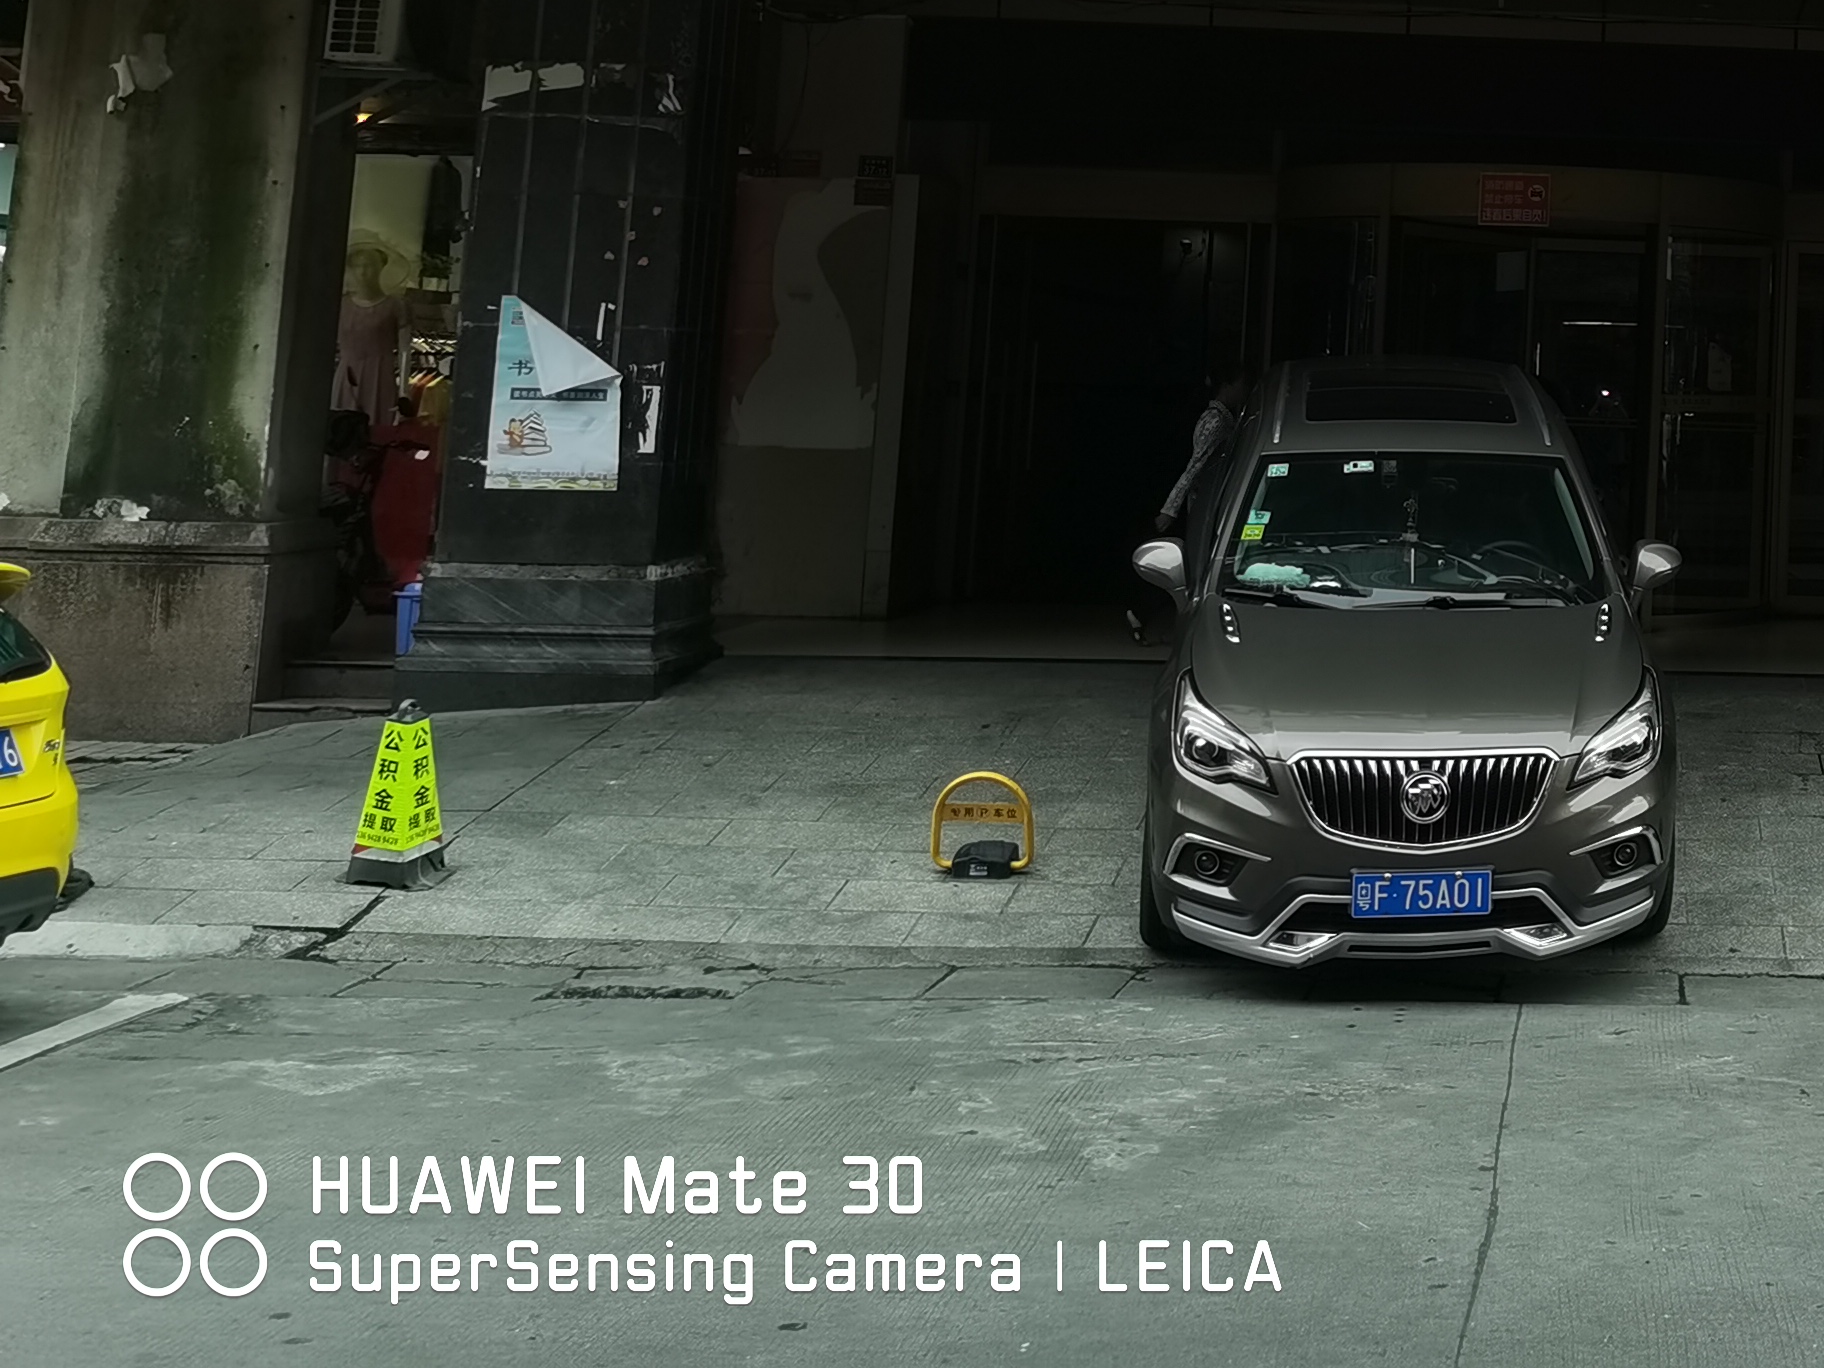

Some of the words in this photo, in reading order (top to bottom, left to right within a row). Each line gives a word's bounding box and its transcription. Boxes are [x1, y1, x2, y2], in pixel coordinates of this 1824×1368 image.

[373, 729, 404, 811] 公积金
[413, 727, 430, 809] 公积金
[363, 812, 396, 833] 提取
[408, 807, 435, 831] 提取
